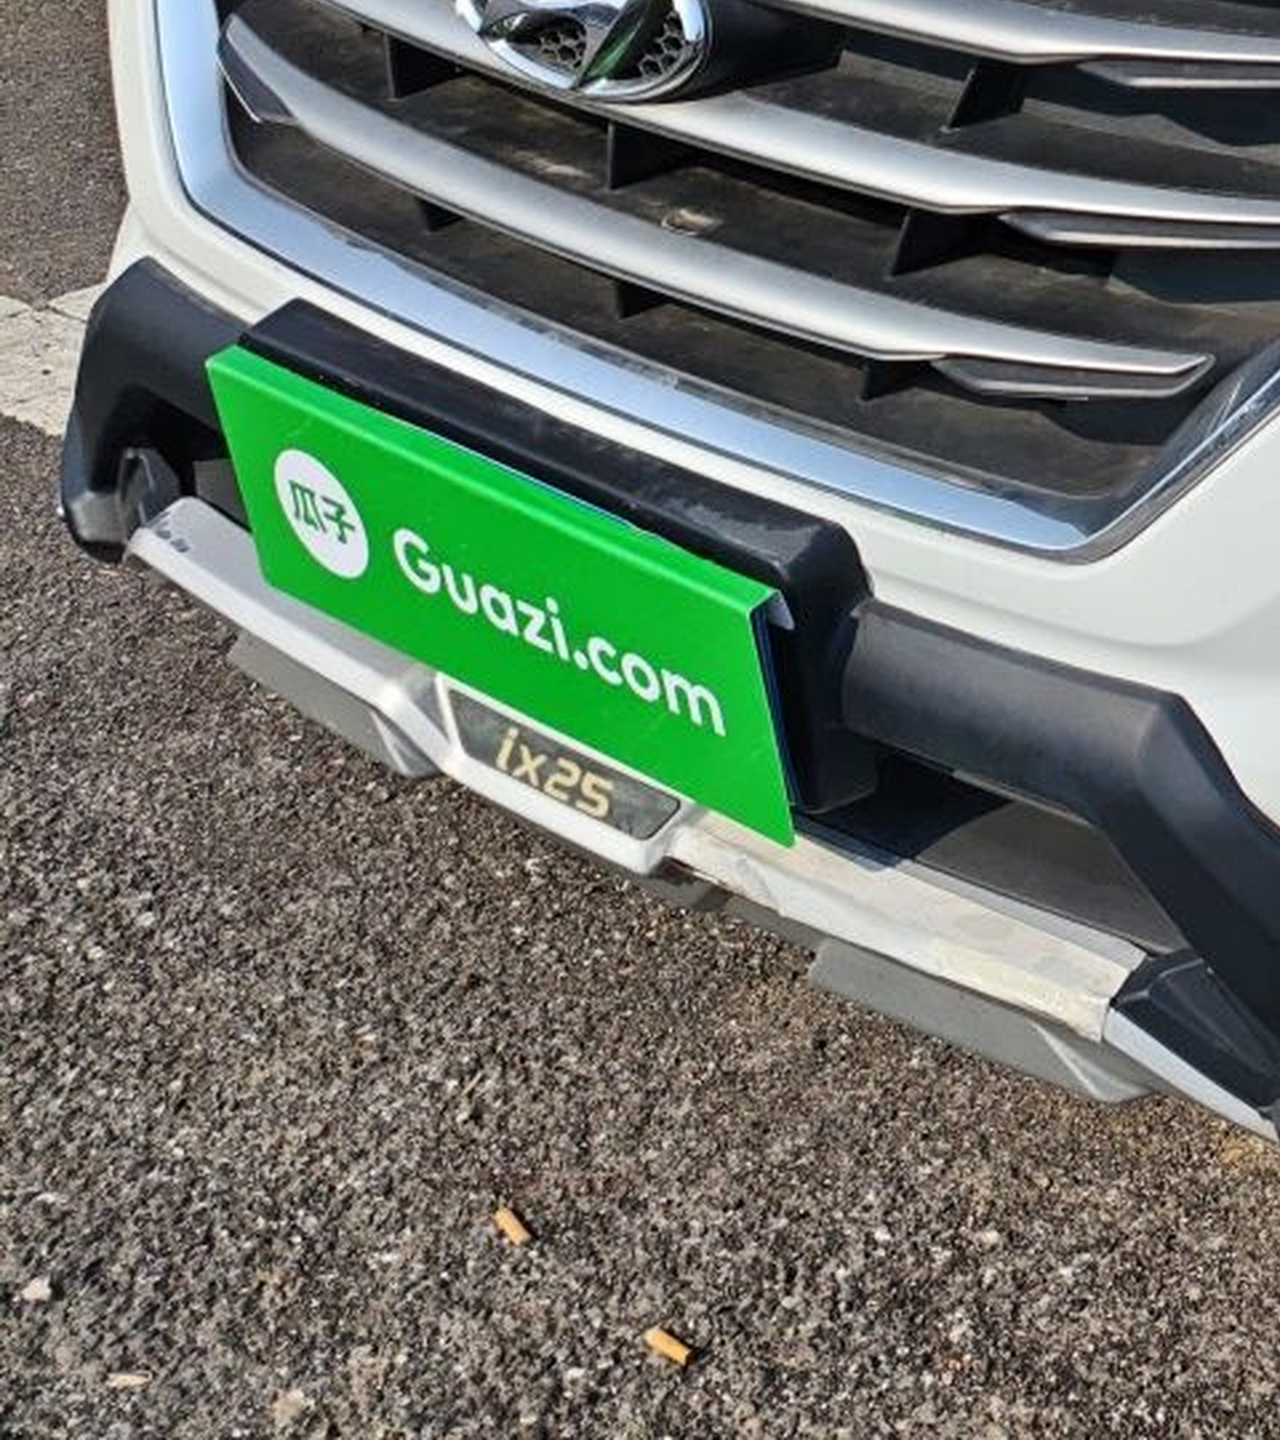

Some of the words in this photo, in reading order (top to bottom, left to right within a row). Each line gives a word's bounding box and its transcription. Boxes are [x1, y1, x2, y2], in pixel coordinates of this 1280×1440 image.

[289, 478, 357, 547] 瓜子
[392, 528, 726, 738] Guazi.com
[496, 726, 615, 821] ix25
